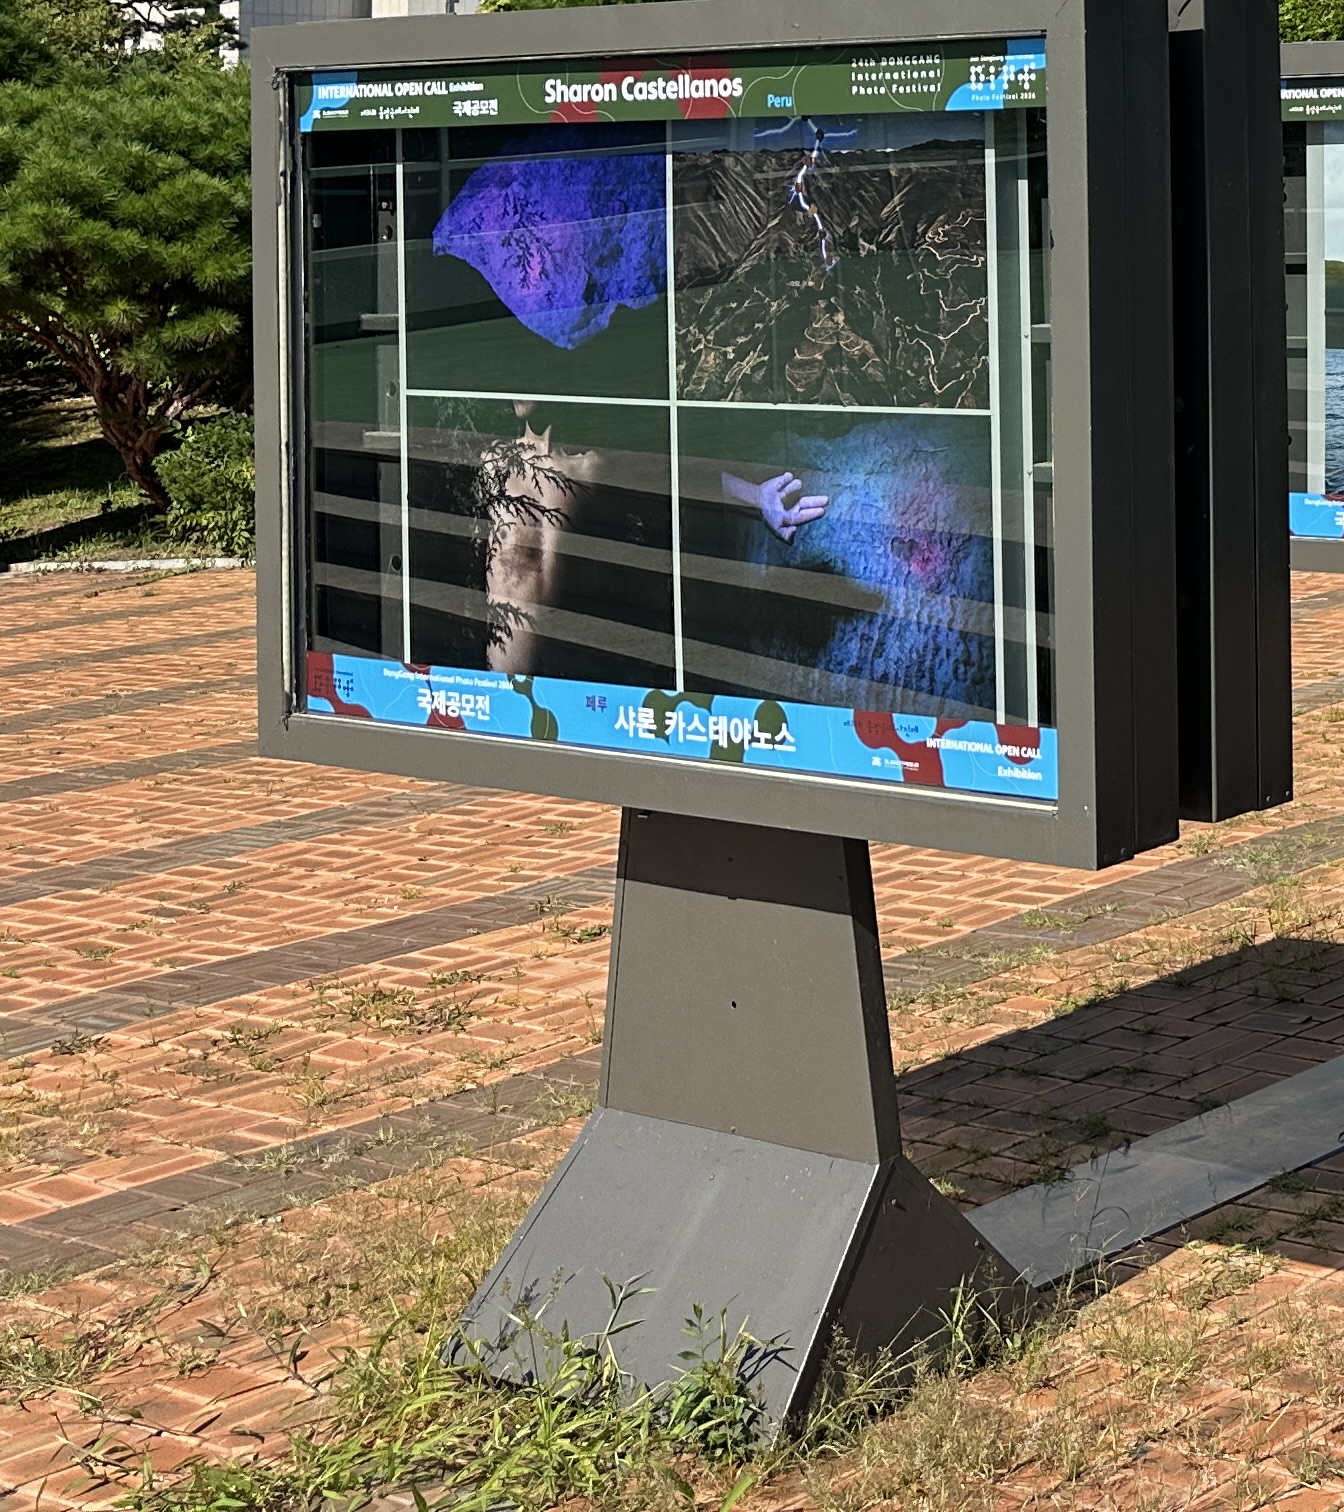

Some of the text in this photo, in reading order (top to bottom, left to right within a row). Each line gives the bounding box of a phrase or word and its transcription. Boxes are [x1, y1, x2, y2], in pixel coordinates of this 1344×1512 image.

[851, 68, 941, 82] International
[318, 83, 394, 99] INTERNATIONAL
[395, 81, 423, 97] OPEN
[424, 80, 448, 95] CALL
[544, 74, 743, 104] Sharon Castellanos
[851, 82, 941, 95] Photo Festival
[1320, 87, 1344, 98] OPEN
[453, 99, 498, 117] 국제공모전
[767, 94, 793, 108] Peru
[416, 687, 491, 720] 국제공모전
[585, 694, 608, 713] 페루
[614, 705, 797, 753] 샤론 카스테야노스
[926, 737, 1043, 759] INTERNATIONAL OPEN CALL
[997, 765, 1043, 781] Exhibition
